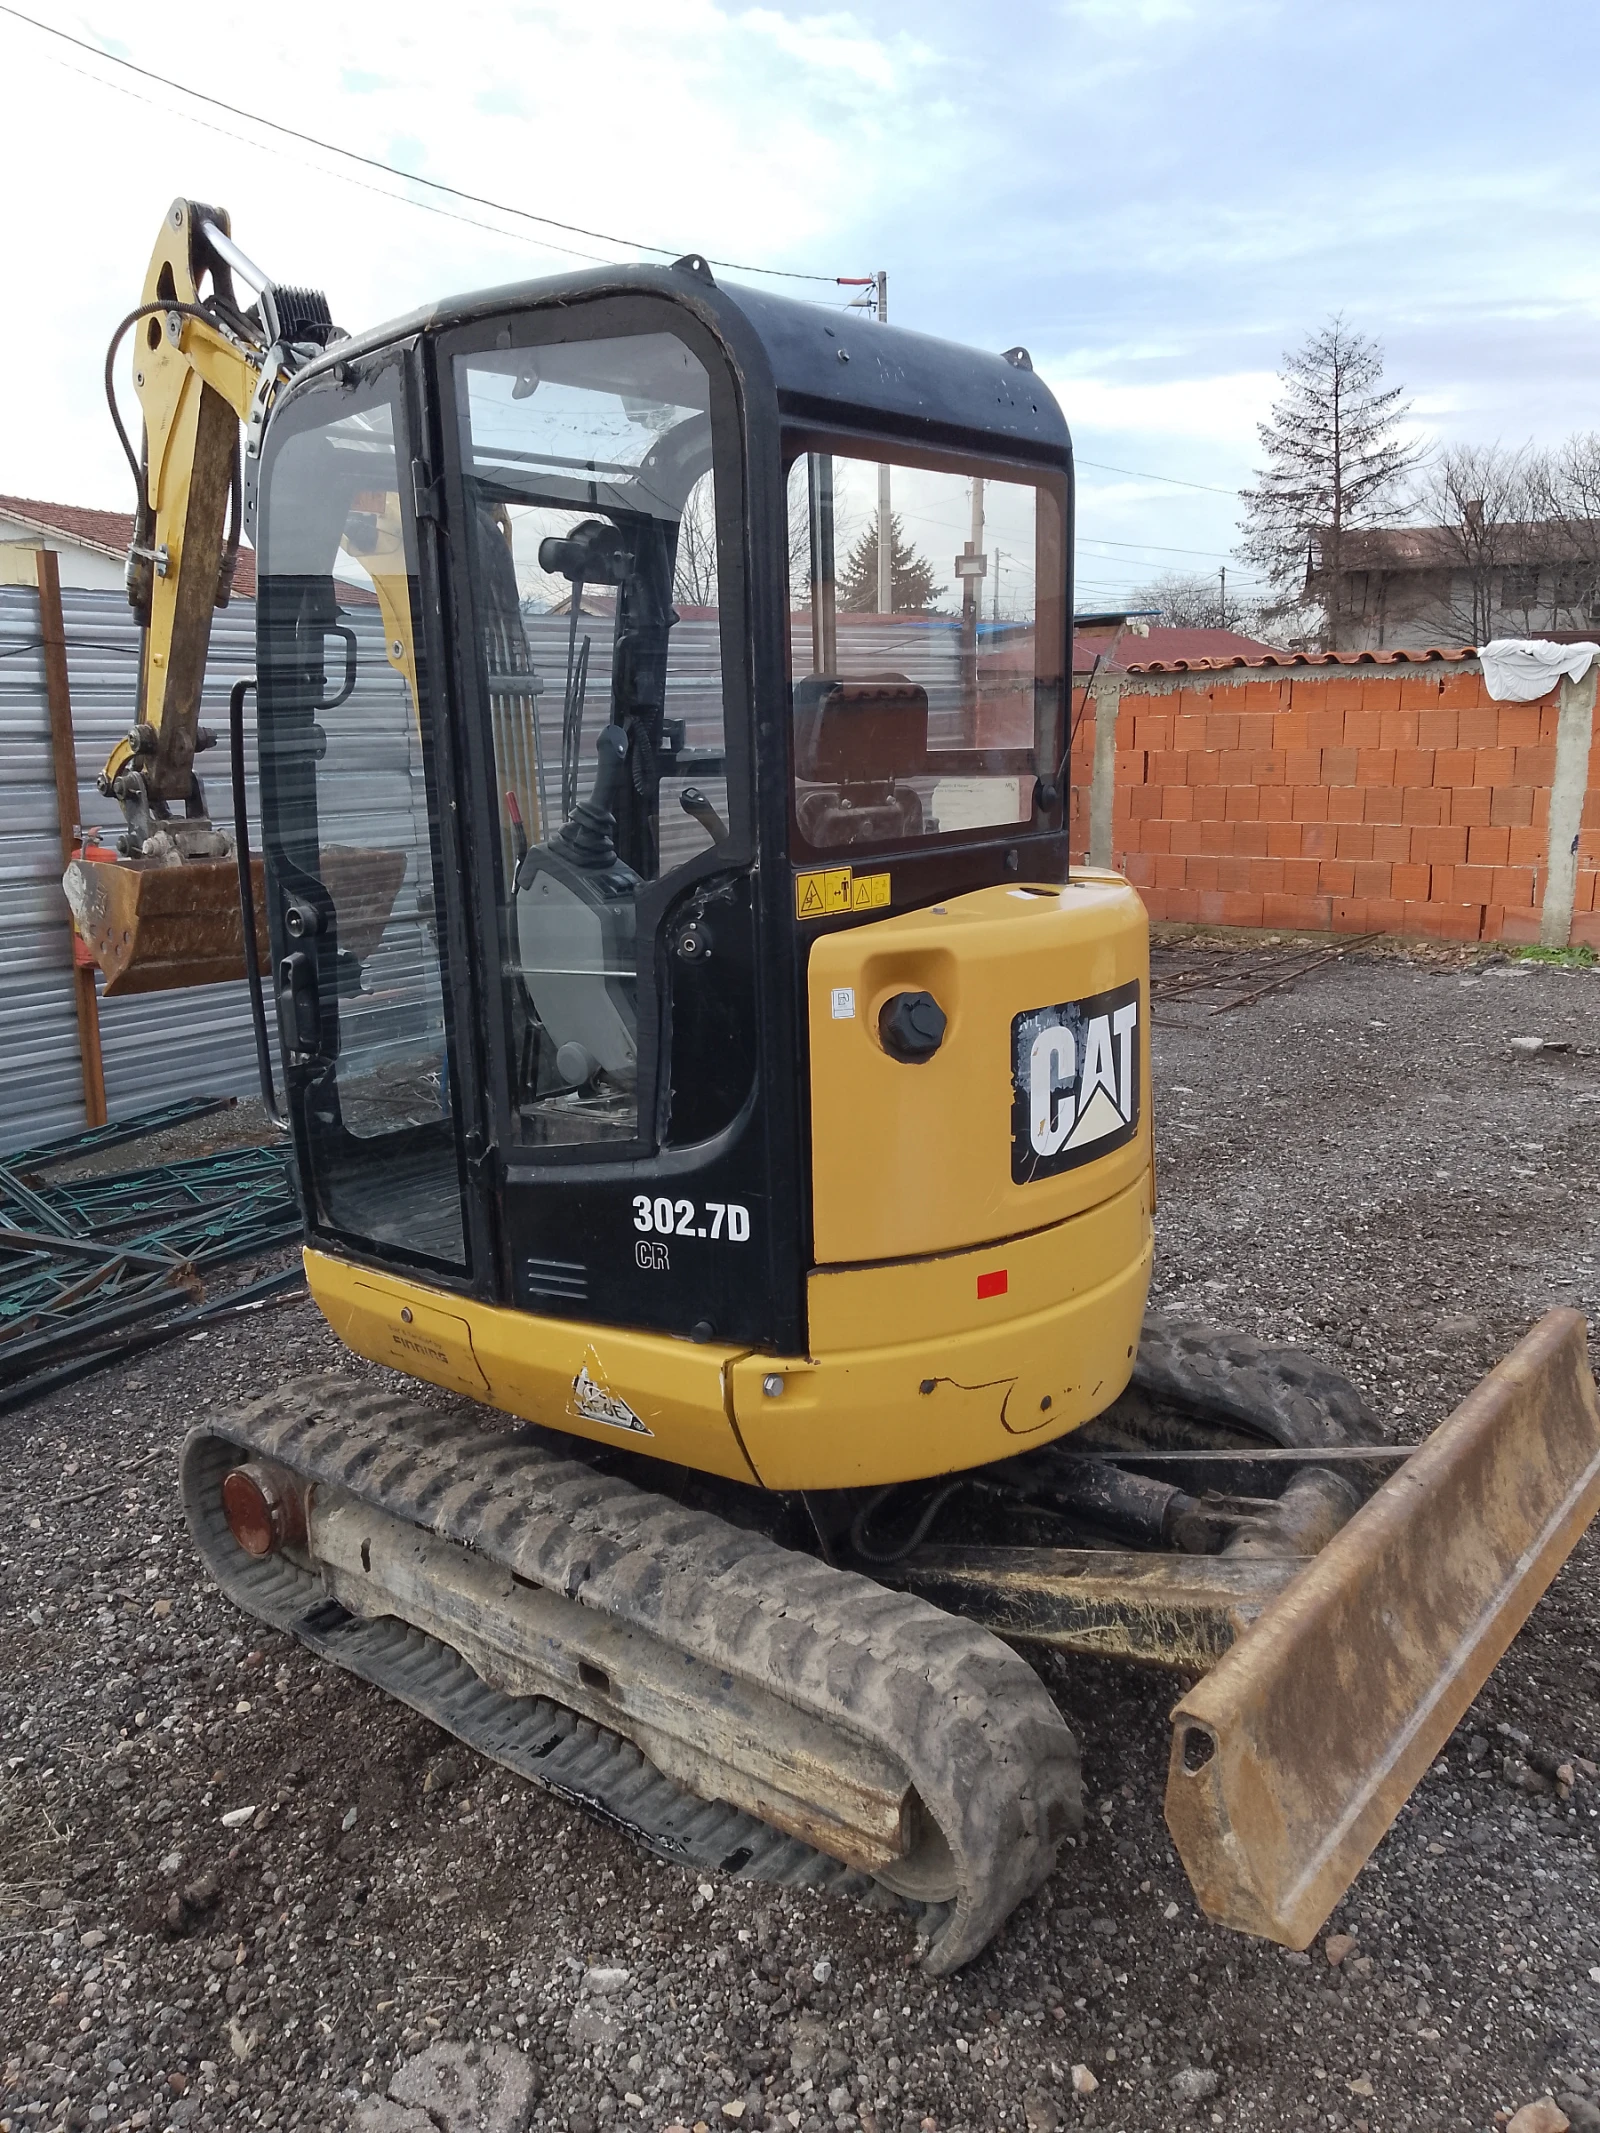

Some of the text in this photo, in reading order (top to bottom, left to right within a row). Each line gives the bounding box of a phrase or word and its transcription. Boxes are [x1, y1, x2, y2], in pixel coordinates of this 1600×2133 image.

[1031, 1001, 1137, 1156] CAT
[633, 1195, 750, 1242] 302.7D
[635, 1240, 670, 1270] CR
